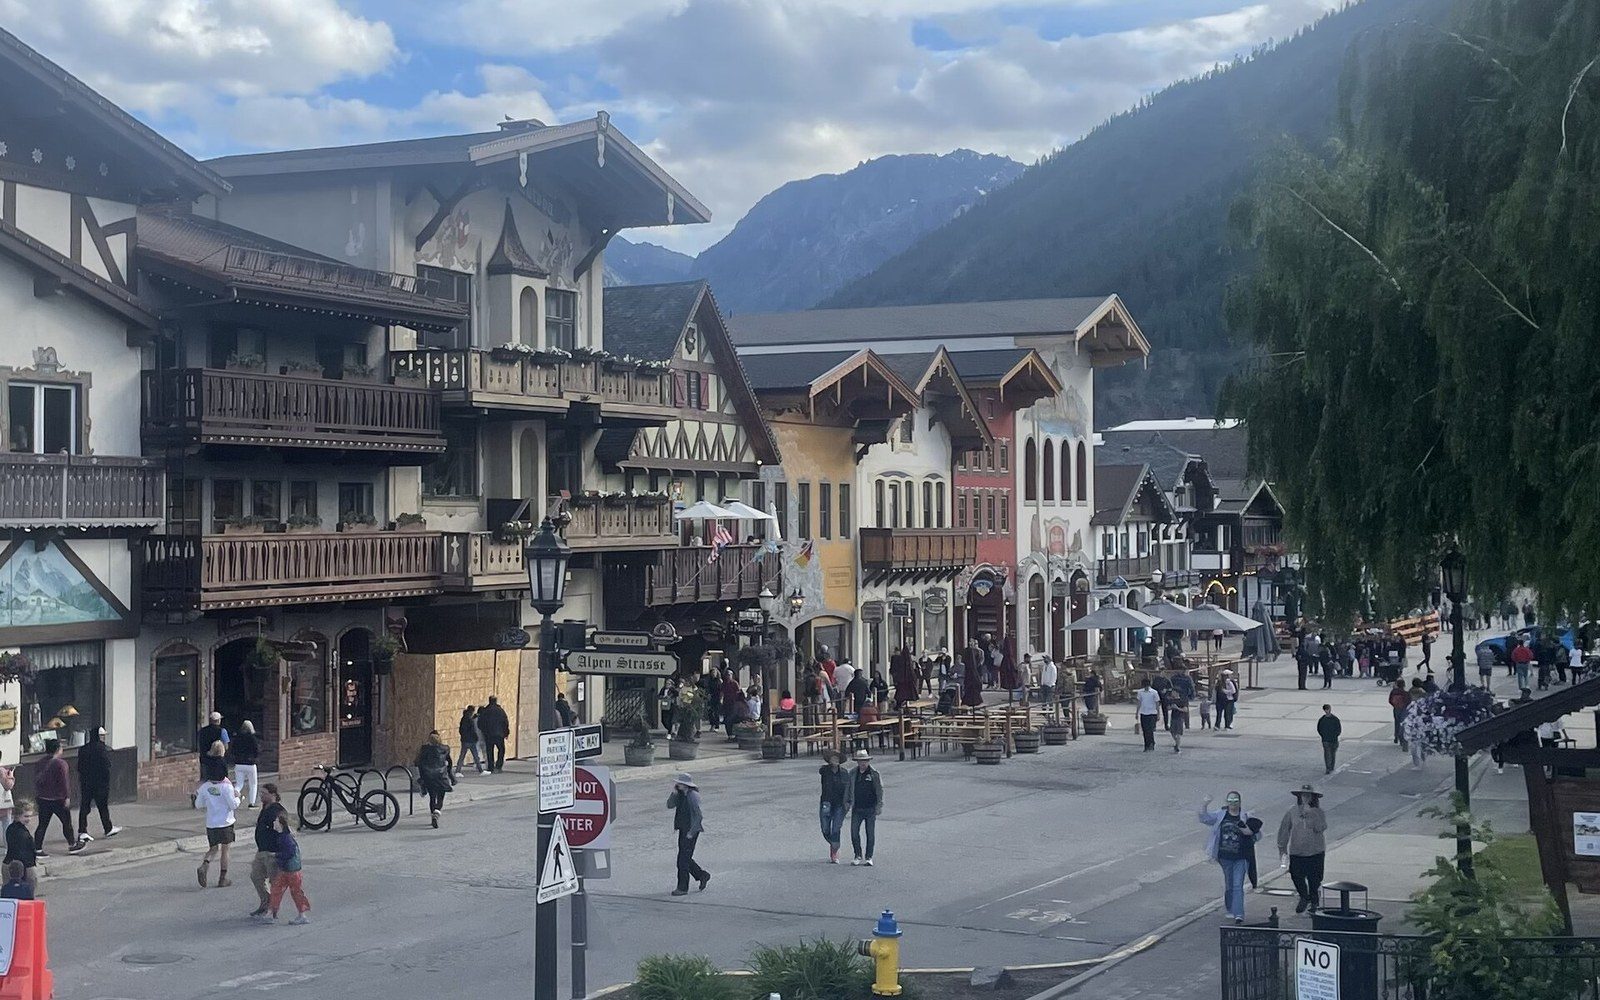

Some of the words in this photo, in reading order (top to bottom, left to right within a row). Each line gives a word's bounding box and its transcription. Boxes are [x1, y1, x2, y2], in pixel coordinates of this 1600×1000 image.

[614, 636, 643, 644] Street
[578, 655, 611, 669] Alpen
[616, 656, 666, 670] Strasse
[548, 735, 566, 745] WINTER
[586, 735, 599, 747] WAY
[546, 745, 567, 754] PARKING
[575, 781, 597, 794] NOT
[562, 818, 593, 831] NTER
[1304, 948, 1330, 969] NO
